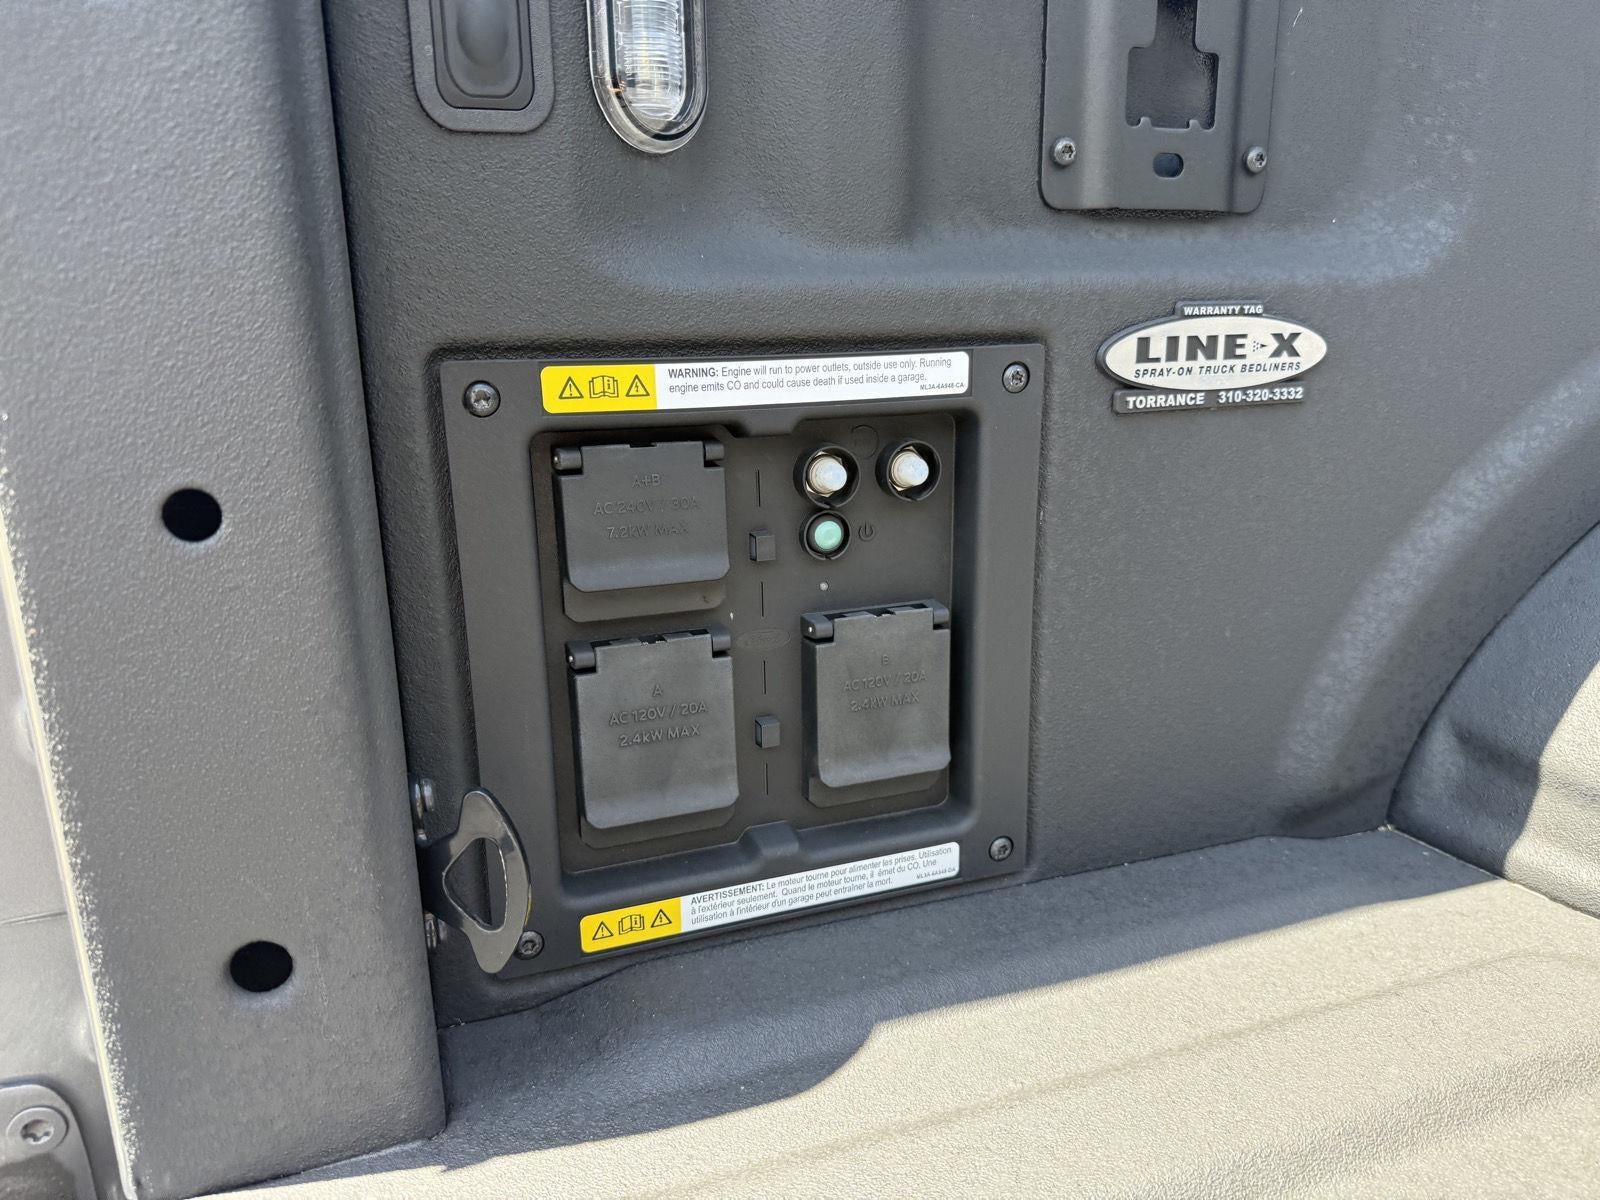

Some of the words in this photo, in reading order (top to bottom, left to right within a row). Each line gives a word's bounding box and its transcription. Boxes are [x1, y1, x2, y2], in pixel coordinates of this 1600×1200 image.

[1183, 305, 1239, 316] WARRANTY
[1243, 304, 1264, 315] TAG
[668, 367, 719, 378] WARNING:
[721, 366, 752, 379] Engine
[753, 365, 767, 376] will
[769, 365, 783, 375] run
[785, 364, 793, 374] to
[794, 364, 819, 374] power
[822, 361, 851, 373] outlets,
[853, 359, 882, 371] outside
[883, 359, 898, 370] use
[899, 358, 918, 371] only.
[919, 357, 952, 370] Running
[1134, 366, 1193, 379] SPRAY-ON
[1198, 364, 1235, 376] TRUCK
[1240, 361, 1301, 373] BEDLINERS
[669, 382, 699, 395] engine
[701, 381, 725, 392] emits
[726, 380, 741, 391] CO
[743, 379, 760, 390] and
[761, 377, 784, 389] could
[786, 377, 811, 388] cause
[812, 376, 836, 387] death
[837, 375, 844, 386] if
[844, 373, 864, 384] used
[865, 372, 889, 384] inside
[897, 371, 927, 383] garage.
[1126, 392, 1205, 409] TORRANCE
[1218, 387, 1304, 404] 310-320-3332
[632, 473, 661, 488] A+B
[593, 501, 614, 517] AC
[652, 684, 663, 697] A
[842, 680, 860, 692] AC
[862, 674, 891, 690] 120V
[903, 670, 927, 683] 20A
[891, 691, 920, 707] MAX
[609, 712, 630, 726] AC
[631, 706, 667, 722] 120V
[680, 701, 708, 716] 20A
[619, 729, 663, 747] 2.4kW
[667, 723, 701, 740] MAX
[690, 883, 765, 905] AVERTISSEMENT:
[766, 881, 776, 890] Le
[777, 877, 804, 888] moteur
[805, 872, 829, 885] tourne
[830, 867, 848, 879] pour
[848, 861, 881, 873] alimenter
[882, 858, 894, 868] les
[894, 855, 917, 868] prises.
[919, 847, 952, 860] Utilisation
[736, 891, 778, 905] seulement.
[781, 885, 807, 896] Quand
[817, 878, 843, 890] moteur
[844, 873, 869, 884] tourne,
[896, 865, 906, 874] du
[922, 858, 937, 868] Une
[691, 911, 728, 925] utilisation
[788, 894, 814, 906] garage
[815, 889, 832, 900] peut
[875, 877, 893, 886] mort.
